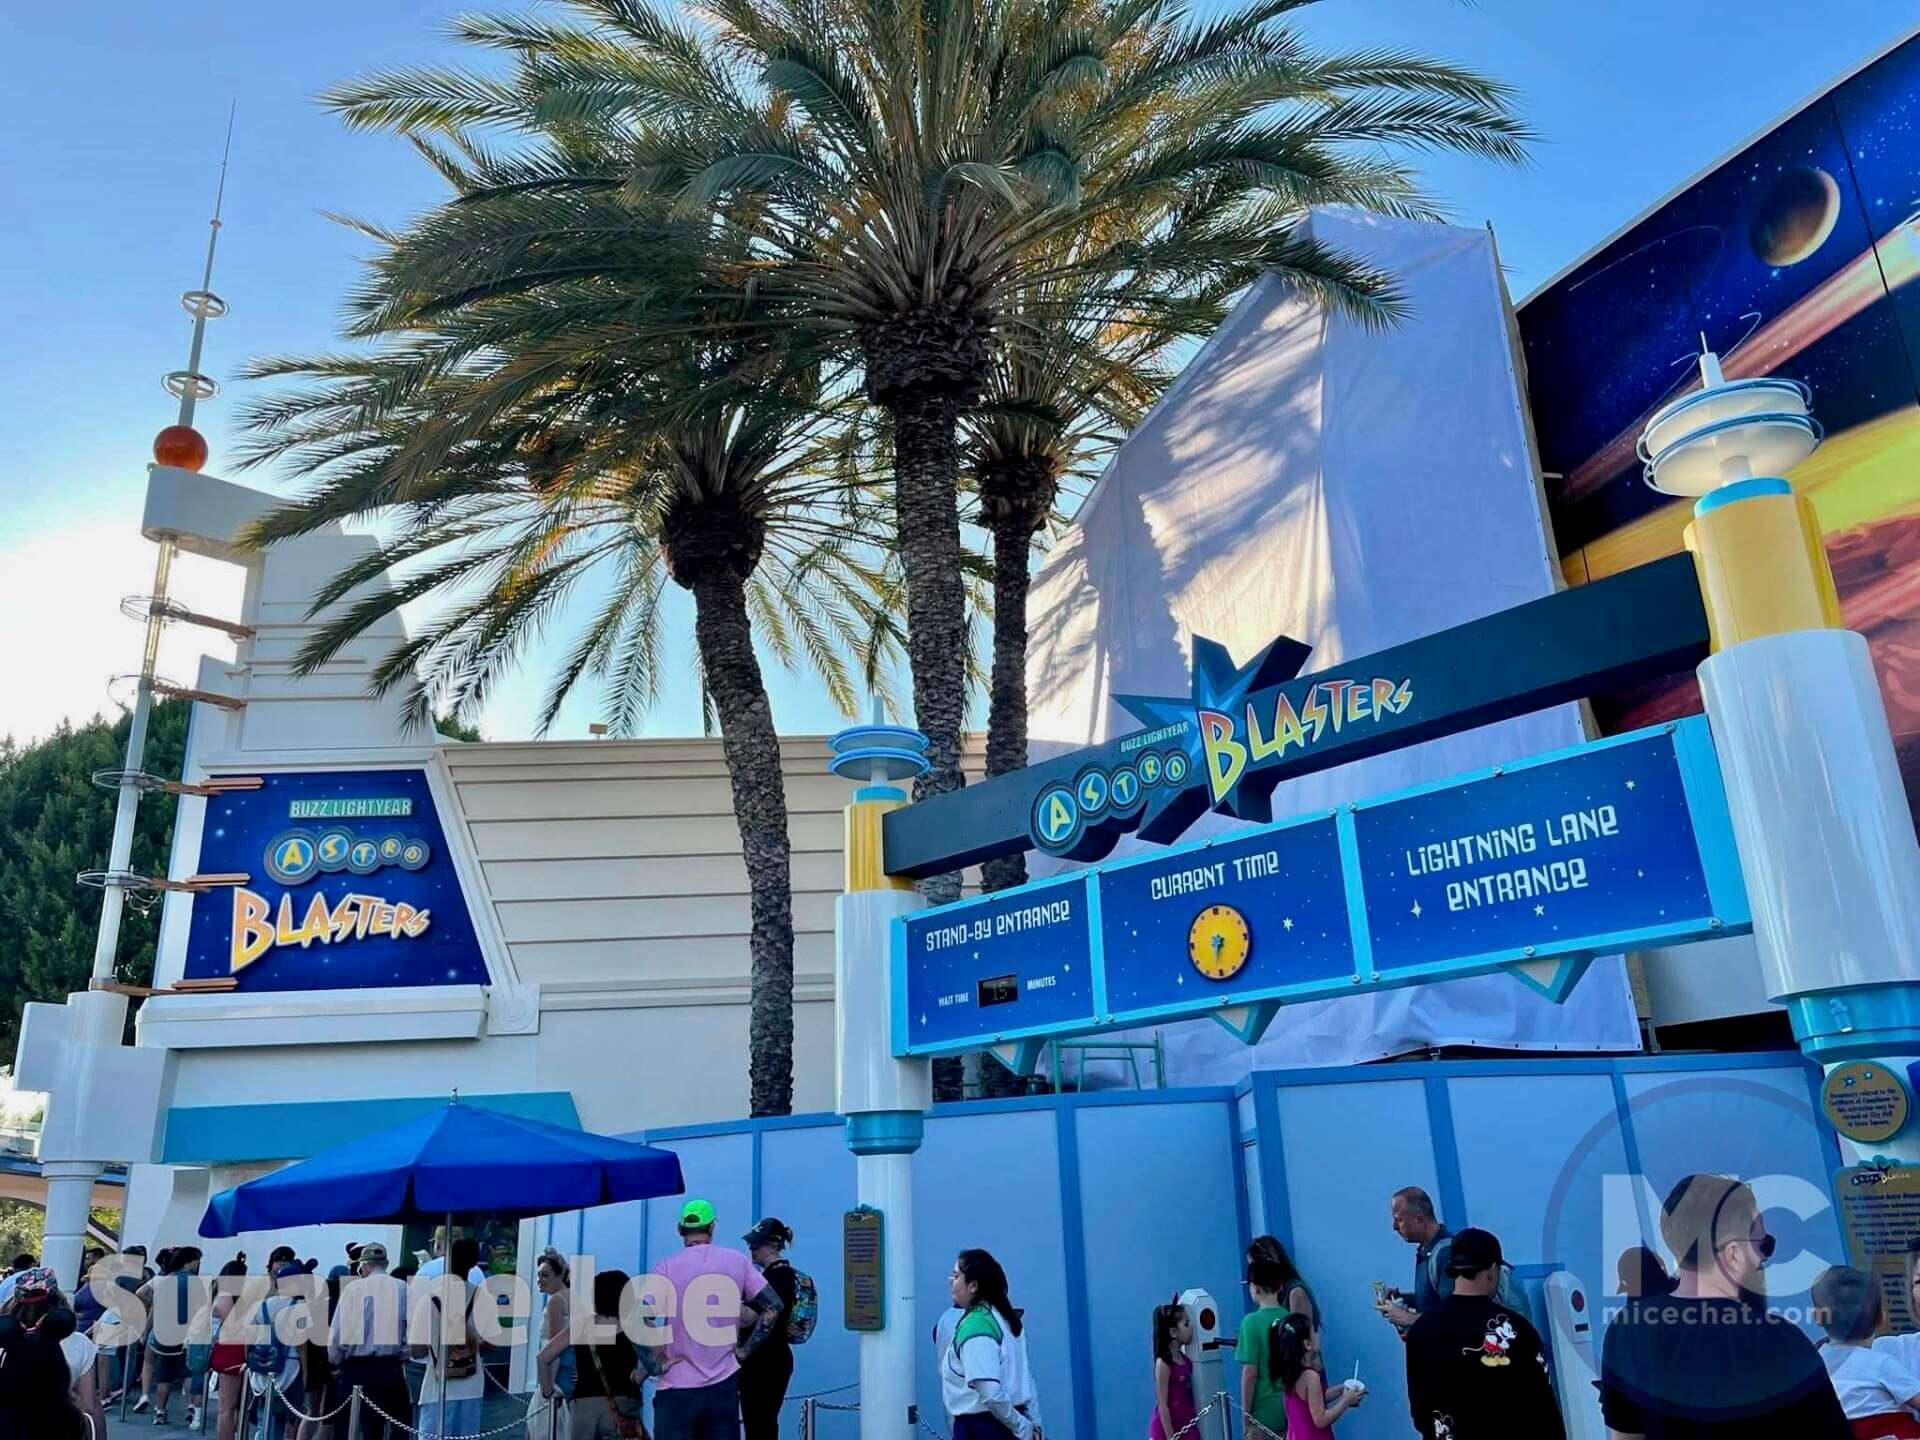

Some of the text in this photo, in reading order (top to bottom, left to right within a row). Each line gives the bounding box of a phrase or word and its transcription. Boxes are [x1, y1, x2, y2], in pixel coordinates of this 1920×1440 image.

[1120, 721, 1189, 752] BUZZ LIGHTYEAR
[1199, 678, 1412, 804] BLASTERS
[290, 798, 412, 818] BUZZ LIGHTYEAR
[1040, 755, 1187, 844] ASTRO
[277, 834, 424, 875] ASTRO
[230, 886, 431, 974] BLASTERS
[926, 921, 992, 951] STAND-BY
[1027, 976, 1056, 990] MINUTES
[938, 992, 969, 1008] WAIT TIME
